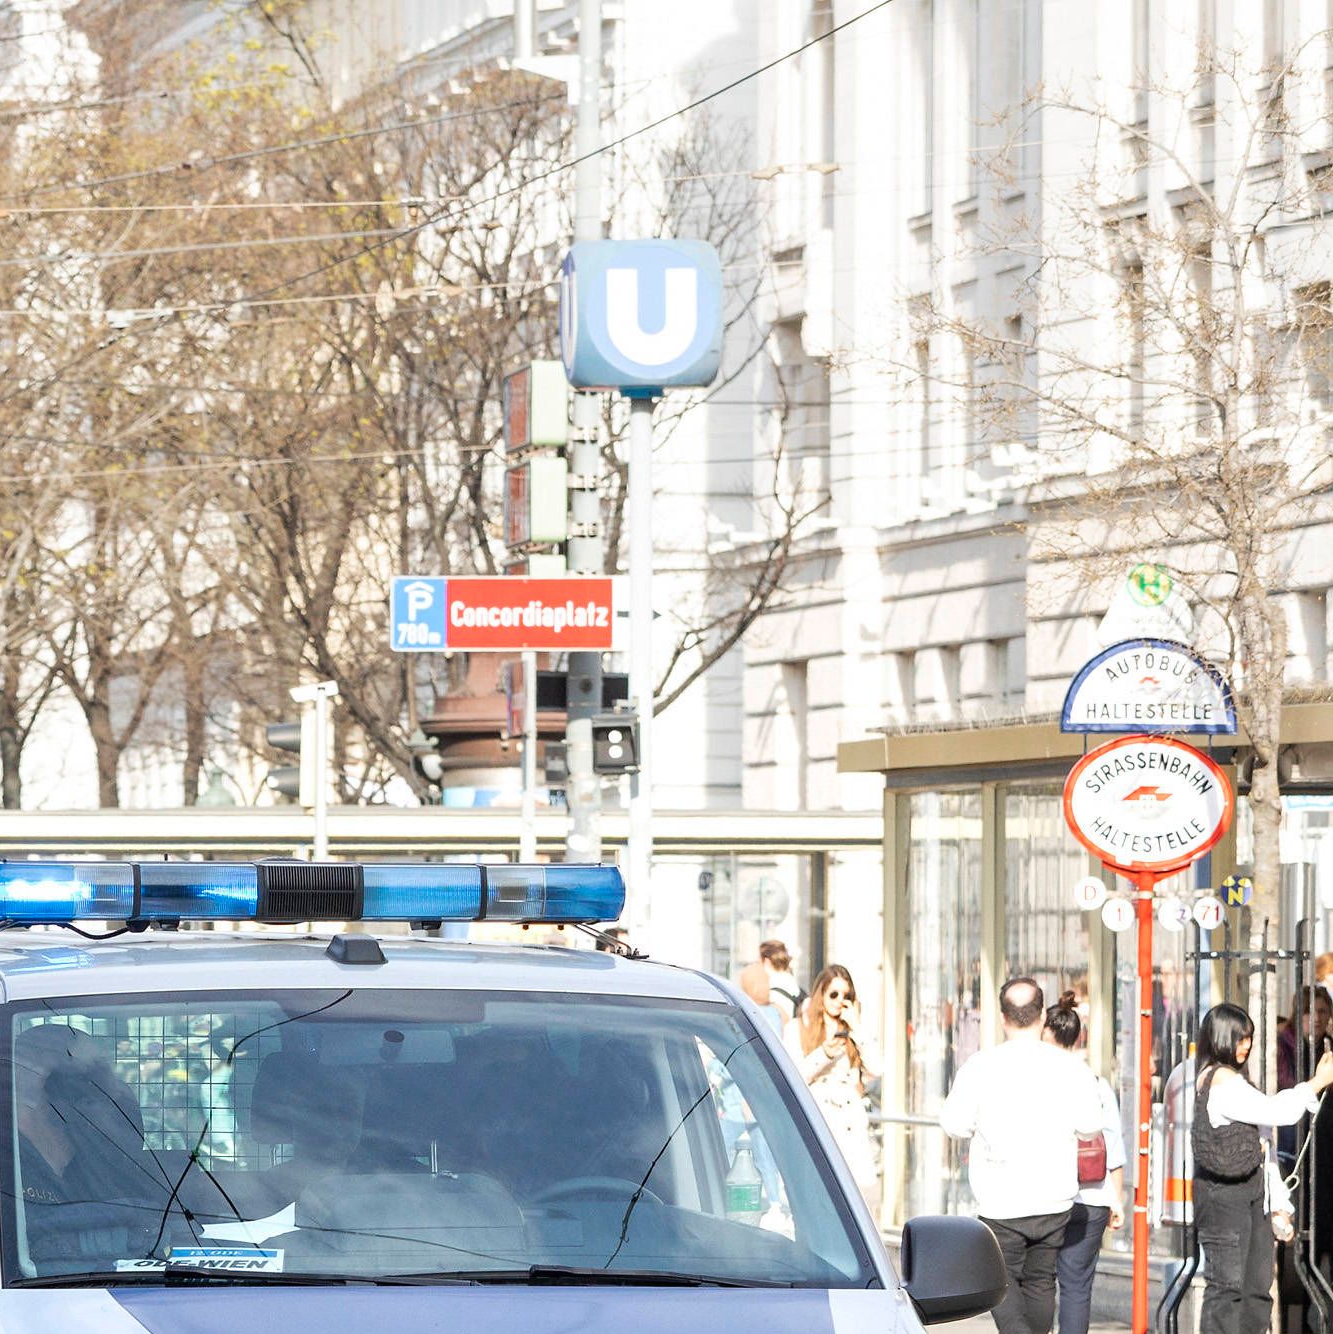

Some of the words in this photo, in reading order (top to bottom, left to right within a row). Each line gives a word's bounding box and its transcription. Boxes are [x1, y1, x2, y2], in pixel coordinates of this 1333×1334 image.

[606, 268, 698, 366] U
[1139, 574, 1160, 592] H
[408, 590, 434, 621] P
[450, 600, 610, 633] Concordiaplatz
[1105, 653, 1199, 685] AUTOBUS
[1086, 703, 1213, 720] HALTESTELLE
[1085, 752, 1214, 796] STRASSENBAHN
[1091, 816, 1206, 853] HALTESTELLE
[1084, 885, 1097, 901] D
[1227, 888, 1244, 906] N
[1201, 906, 1220, 922] 71
